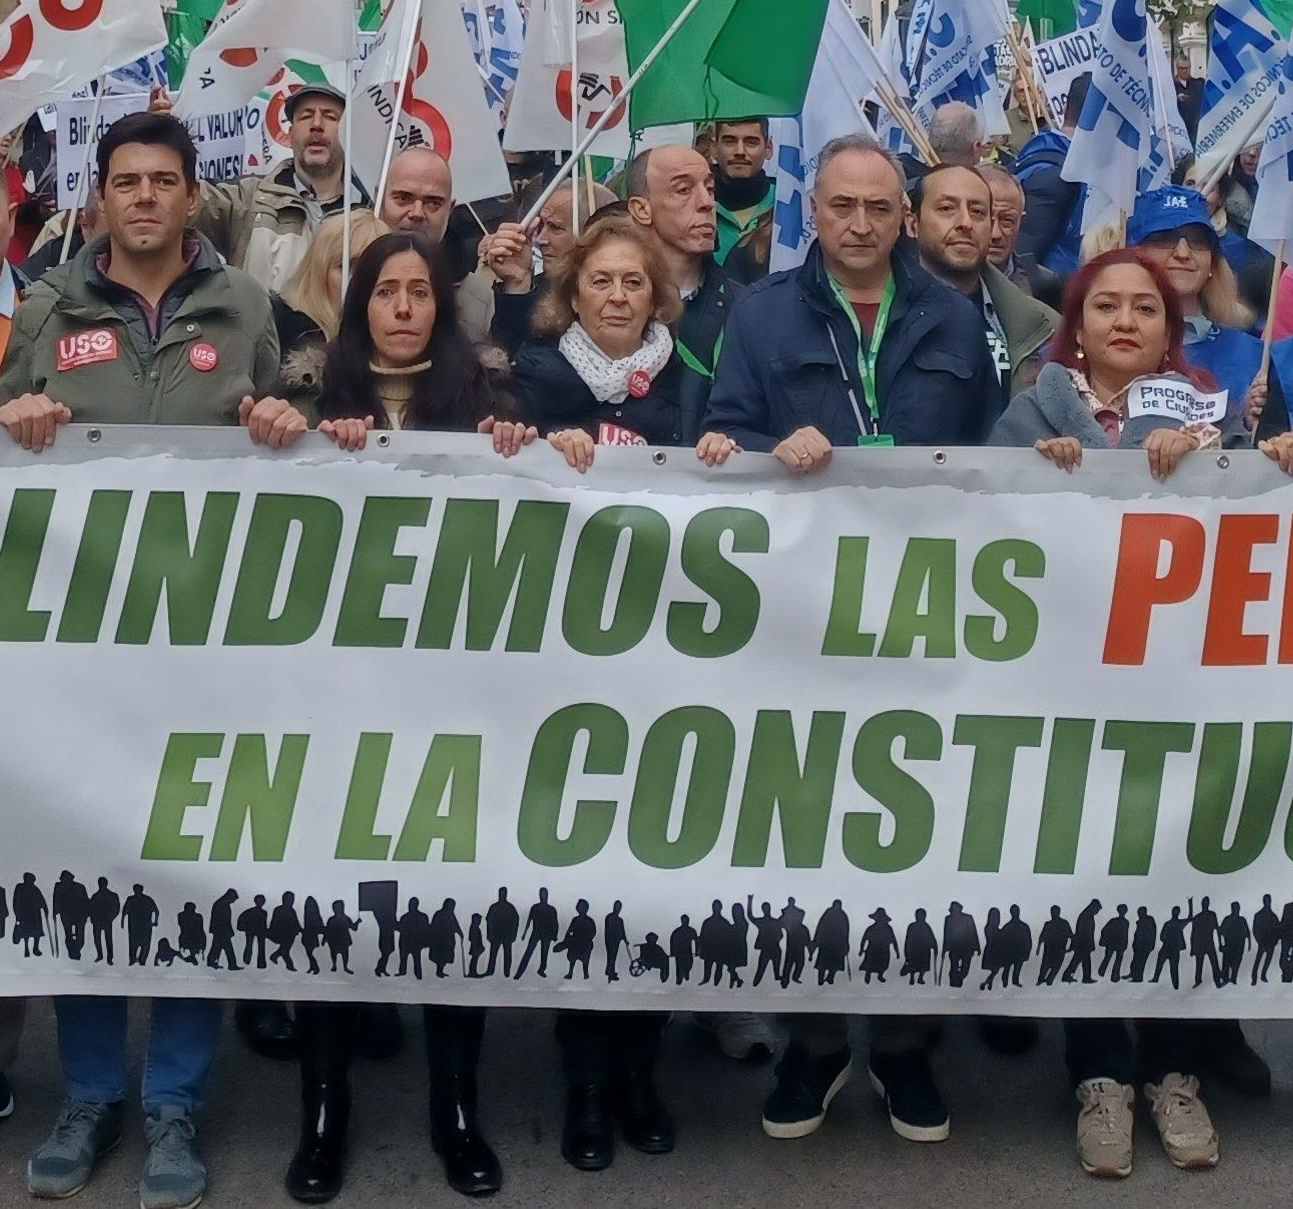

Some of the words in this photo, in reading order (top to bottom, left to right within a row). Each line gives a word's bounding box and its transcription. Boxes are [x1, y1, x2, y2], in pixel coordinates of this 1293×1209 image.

[60, 330, 113, 359] USO
[193, 347, 217, 362] USO
[821, 536, 1046, 660] LAS
[140, 732, 310, 861] EN
[335, 732, 482, 861] LA
